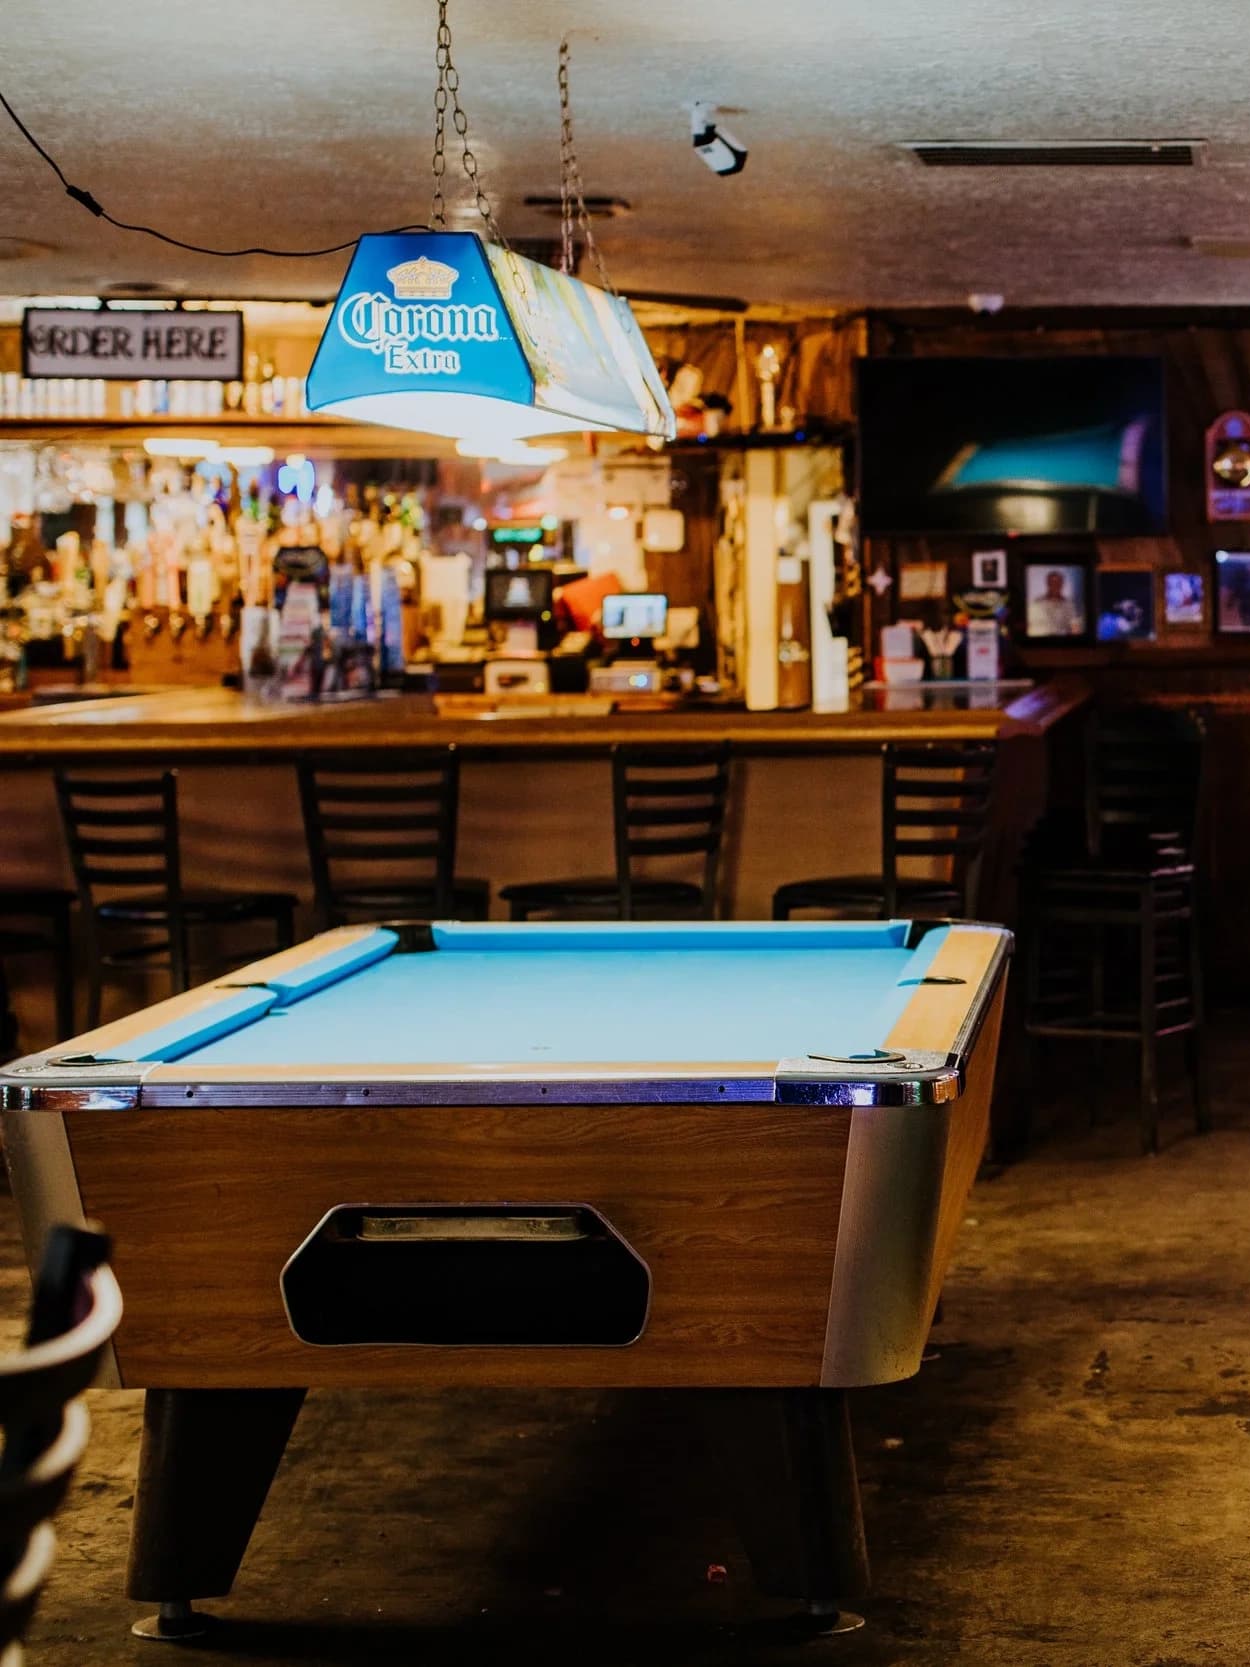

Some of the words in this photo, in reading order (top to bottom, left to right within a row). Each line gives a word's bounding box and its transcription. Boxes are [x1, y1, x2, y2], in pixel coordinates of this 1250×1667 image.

[338, 291, 499, 354] Corona
[29, 324, 134, 361] ORDER
[141, 325, 229, 360] HERE
[385, 341, 460, 374] Extra
